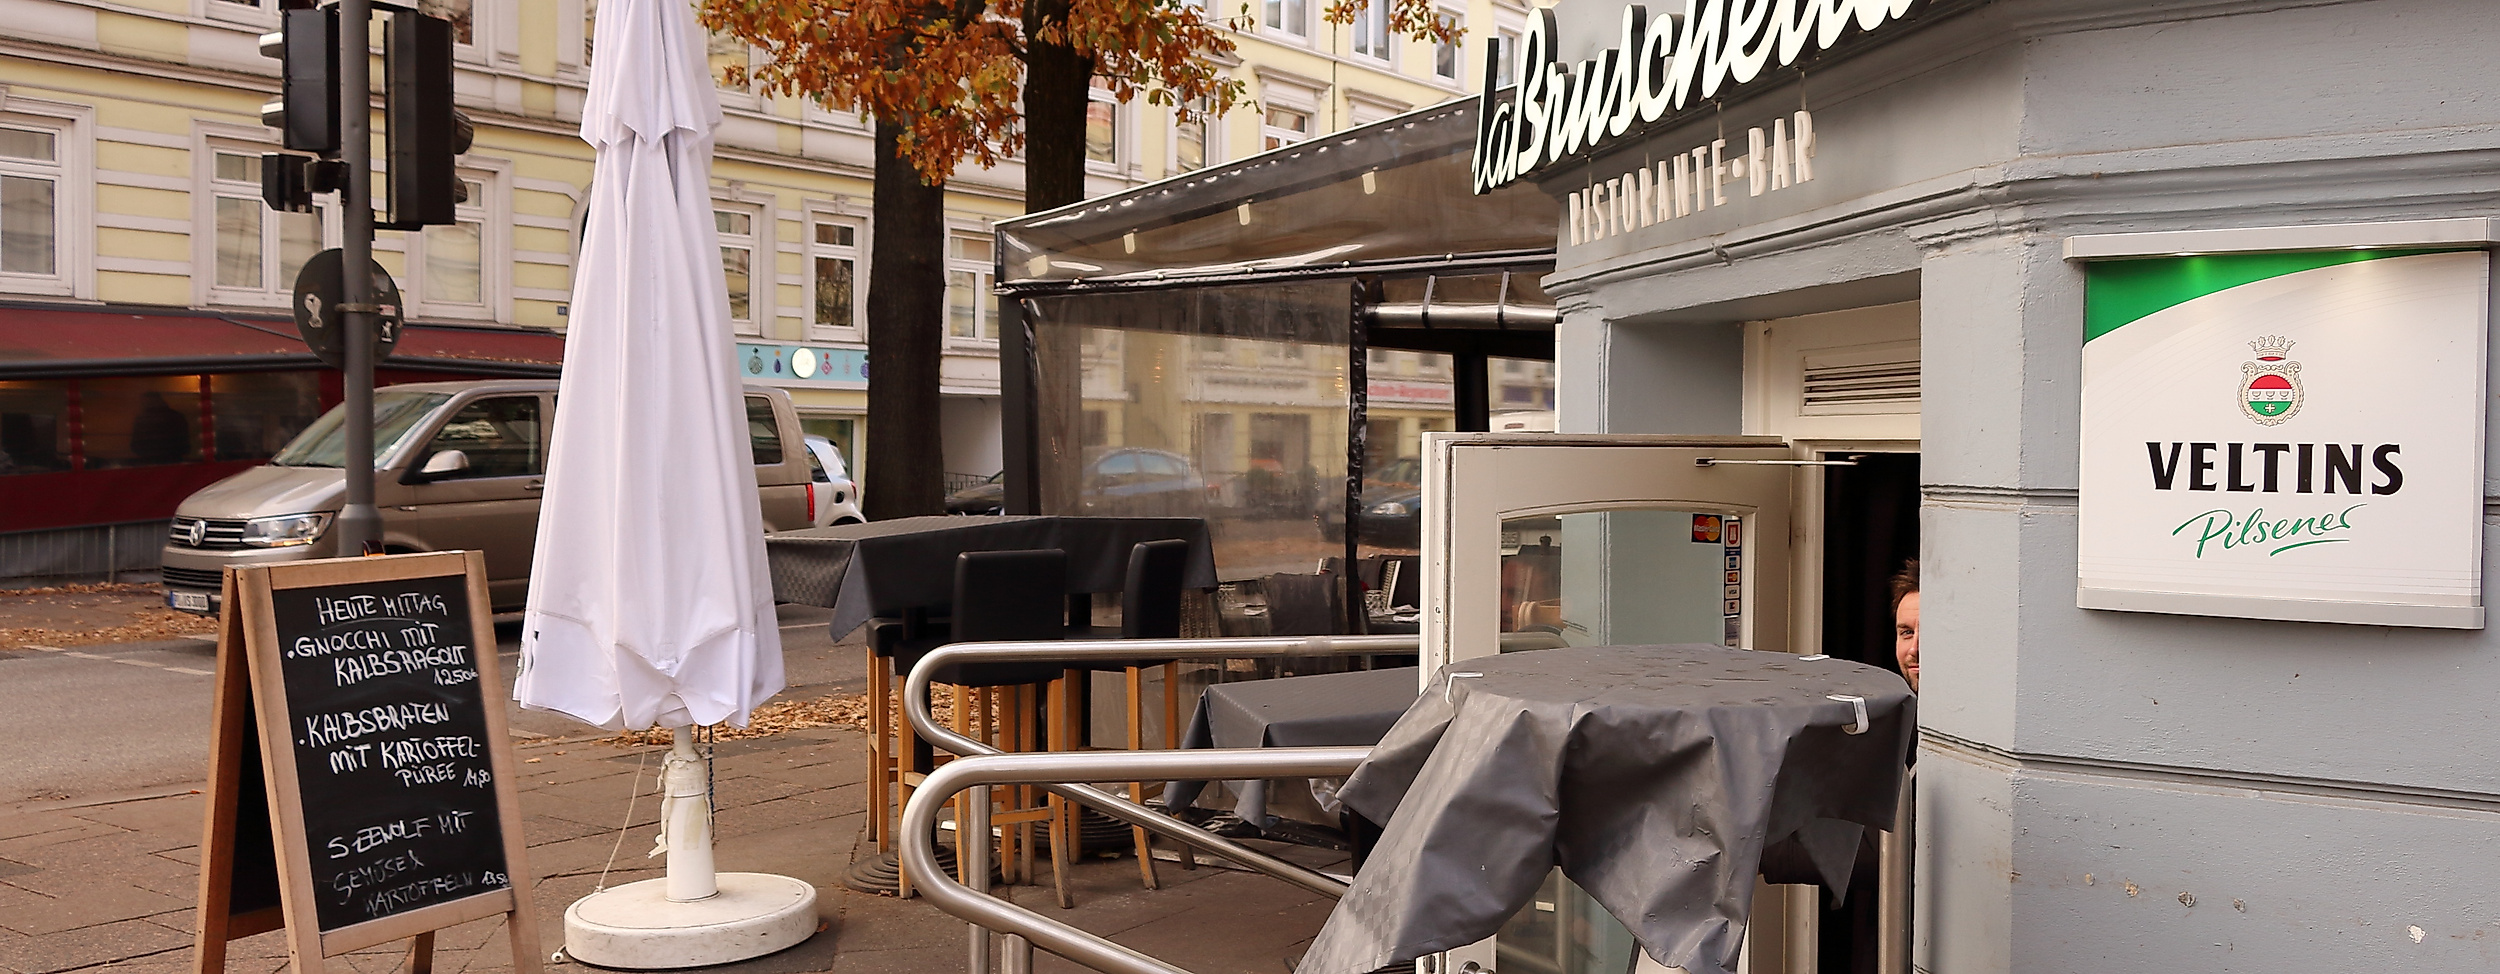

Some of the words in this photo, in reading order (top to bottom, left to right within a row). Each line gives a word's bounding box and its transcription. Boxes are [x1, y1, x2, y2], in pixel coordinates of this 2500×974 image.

[2145, 441, 2405, 496] VELTINS
[2172, 503, 2367, 559] Pilsener
[315, 595, 377, 625] HEUTE
[382, 593, 448, 617] MITTAG
[294, 630, 391, 658] GNOCCHI
[334, 645, 467, 687] KALBSRAGOUT
[305, 702, 450, 748] KALBSBRATEN
[394, 761, 457, 788] PÜREE
